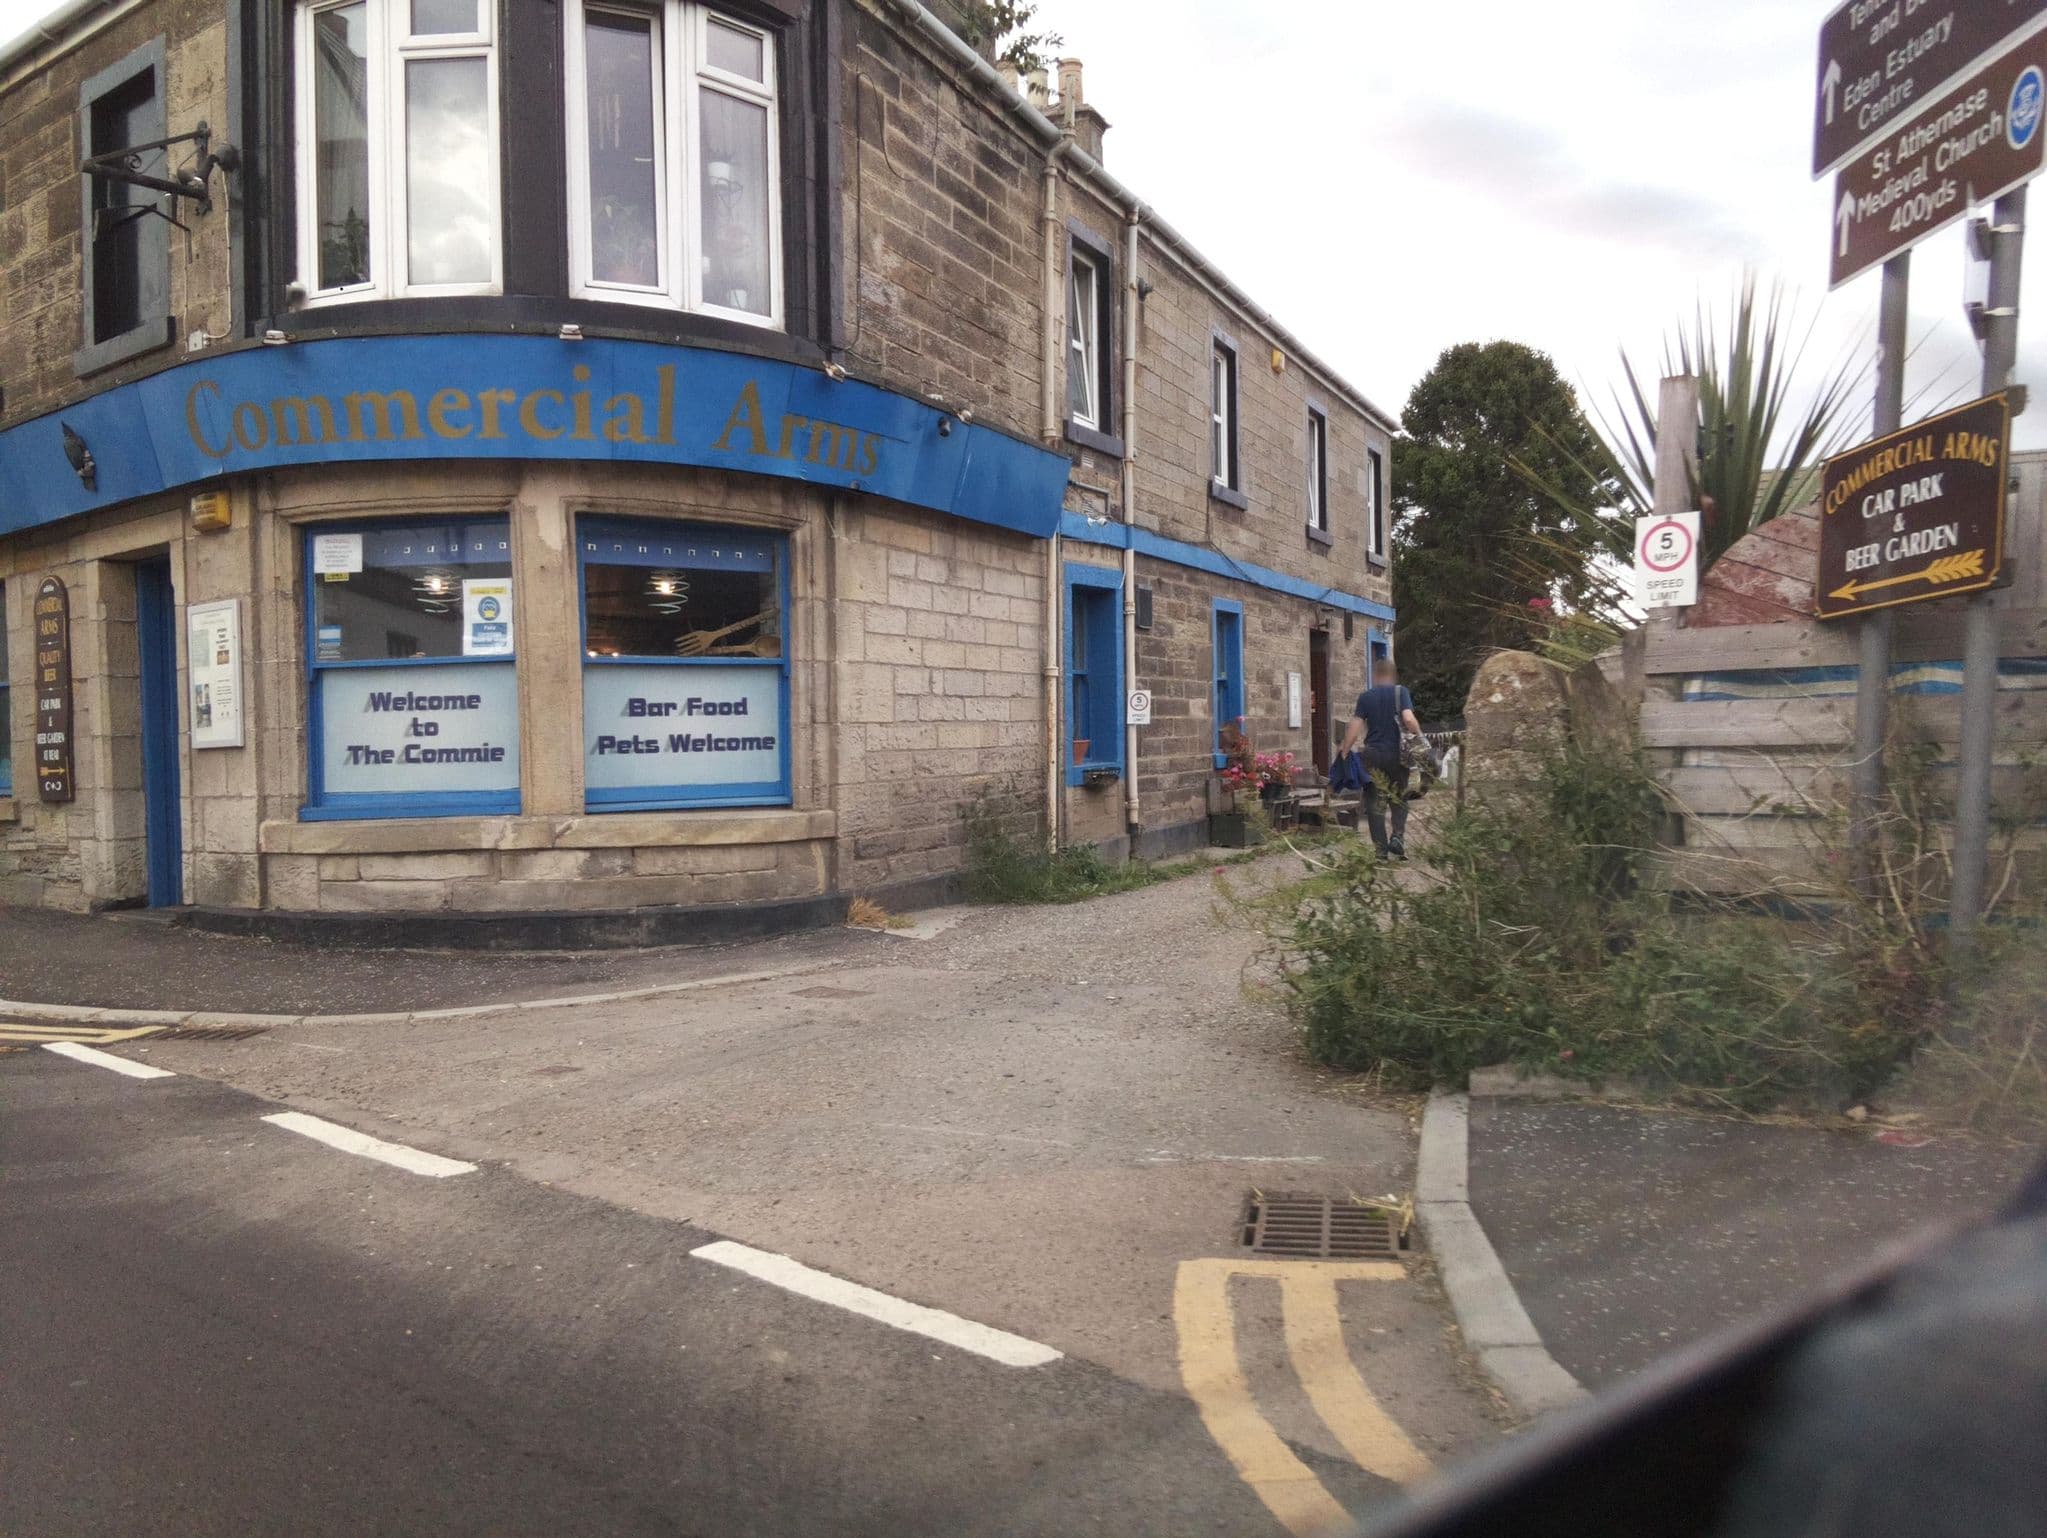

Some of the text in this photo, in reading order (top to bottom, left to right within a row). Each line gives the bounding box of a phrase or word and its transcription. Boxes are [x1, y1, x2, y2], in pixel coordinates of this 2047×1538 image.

[1869, 1, 1900, 45] and
[1843, 12, 1954, 113] Eden Estuary
[1858, 78, 1914, 130] Centre
[1872, 88, 1988, 179] St Athernase
[1856, 111, 2003, 223] Medieval Church
[1888, 180, 1957, 233] 400yds
[185, 364, 884, 477] Commercial Arms
[1825, 431, 1999, 515] COMMERCIAL ARMS
[1862, 473, 1945, 519] CAR PARK
[1660, 532, 1673, 550] 5
[1892, 513, 1906, 533] &
[1654, 552, 1679, 562] MPH
[1845, 522, 1959, 573] BEER GARDEN
[1646, 578, 1684, 590] SPEED
[369, 692, 481, 712] Welcome
[628, 697, 749, 718] Bar Food
[411, 718, 439, 737] to
[598, 734, 777, 755] Pets Welcome
[348, 743, 505, 765] The Commie
